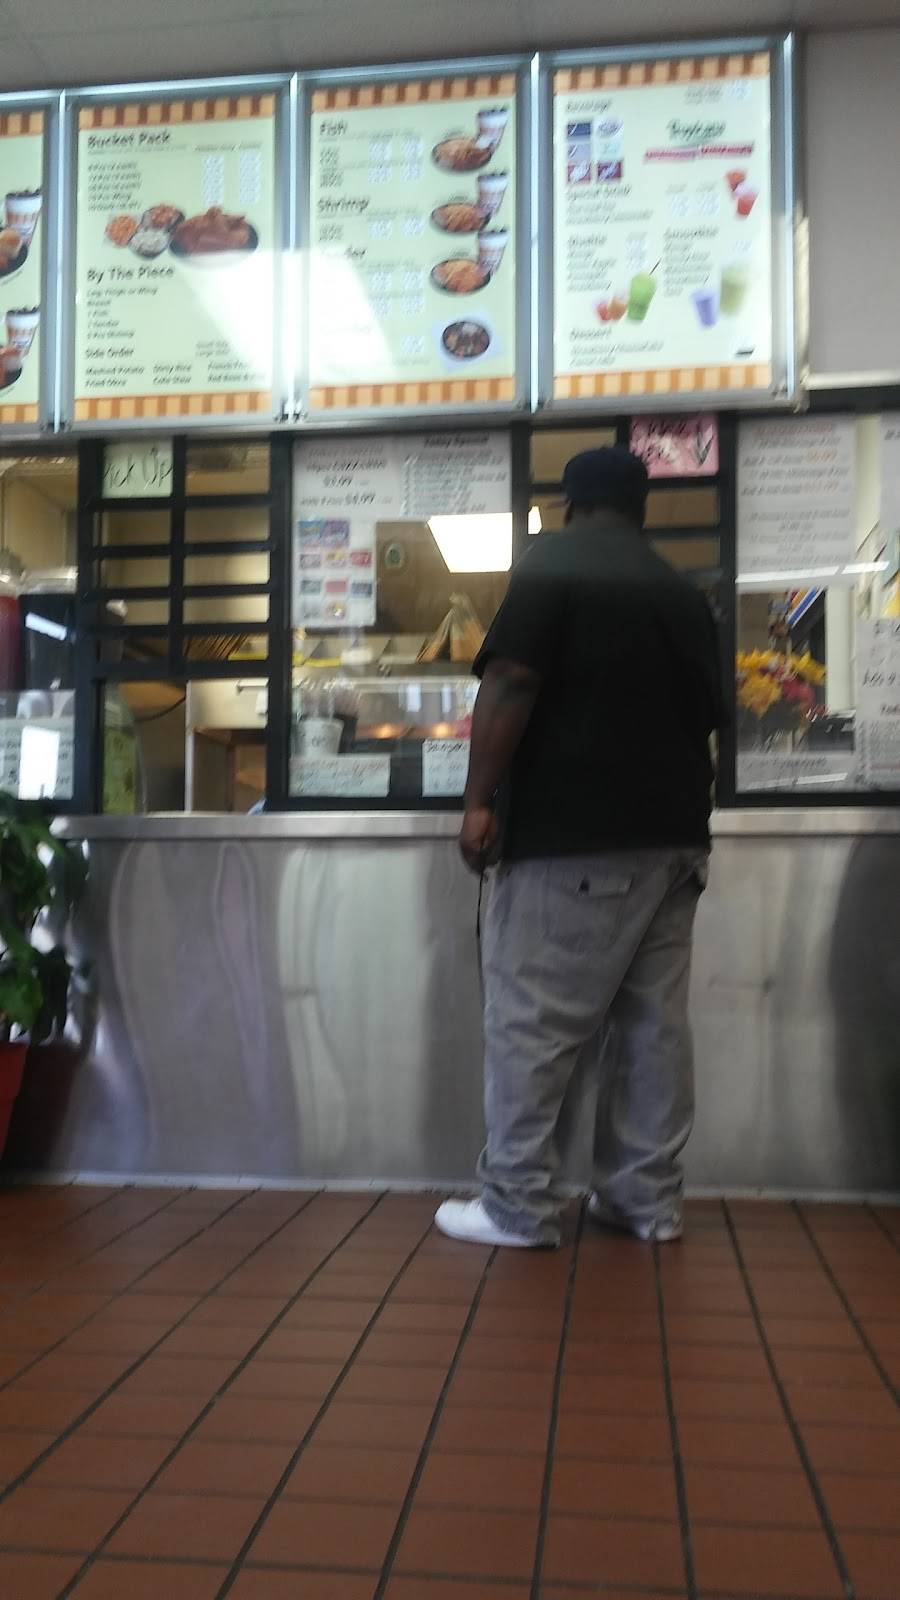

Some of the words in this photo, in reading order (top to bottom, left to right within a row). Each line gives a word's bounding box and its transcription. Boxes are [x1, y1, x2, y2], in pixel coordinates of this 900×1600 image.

[87, 134, 134, 148] Bucket
[138, 130, 170, 145] Pack
[318, 199, 369, 213] Shrimp
[87, 269, 104, 284] By
[109, 267, 133, 280] The
[138, 266, 174, 280] Piece
